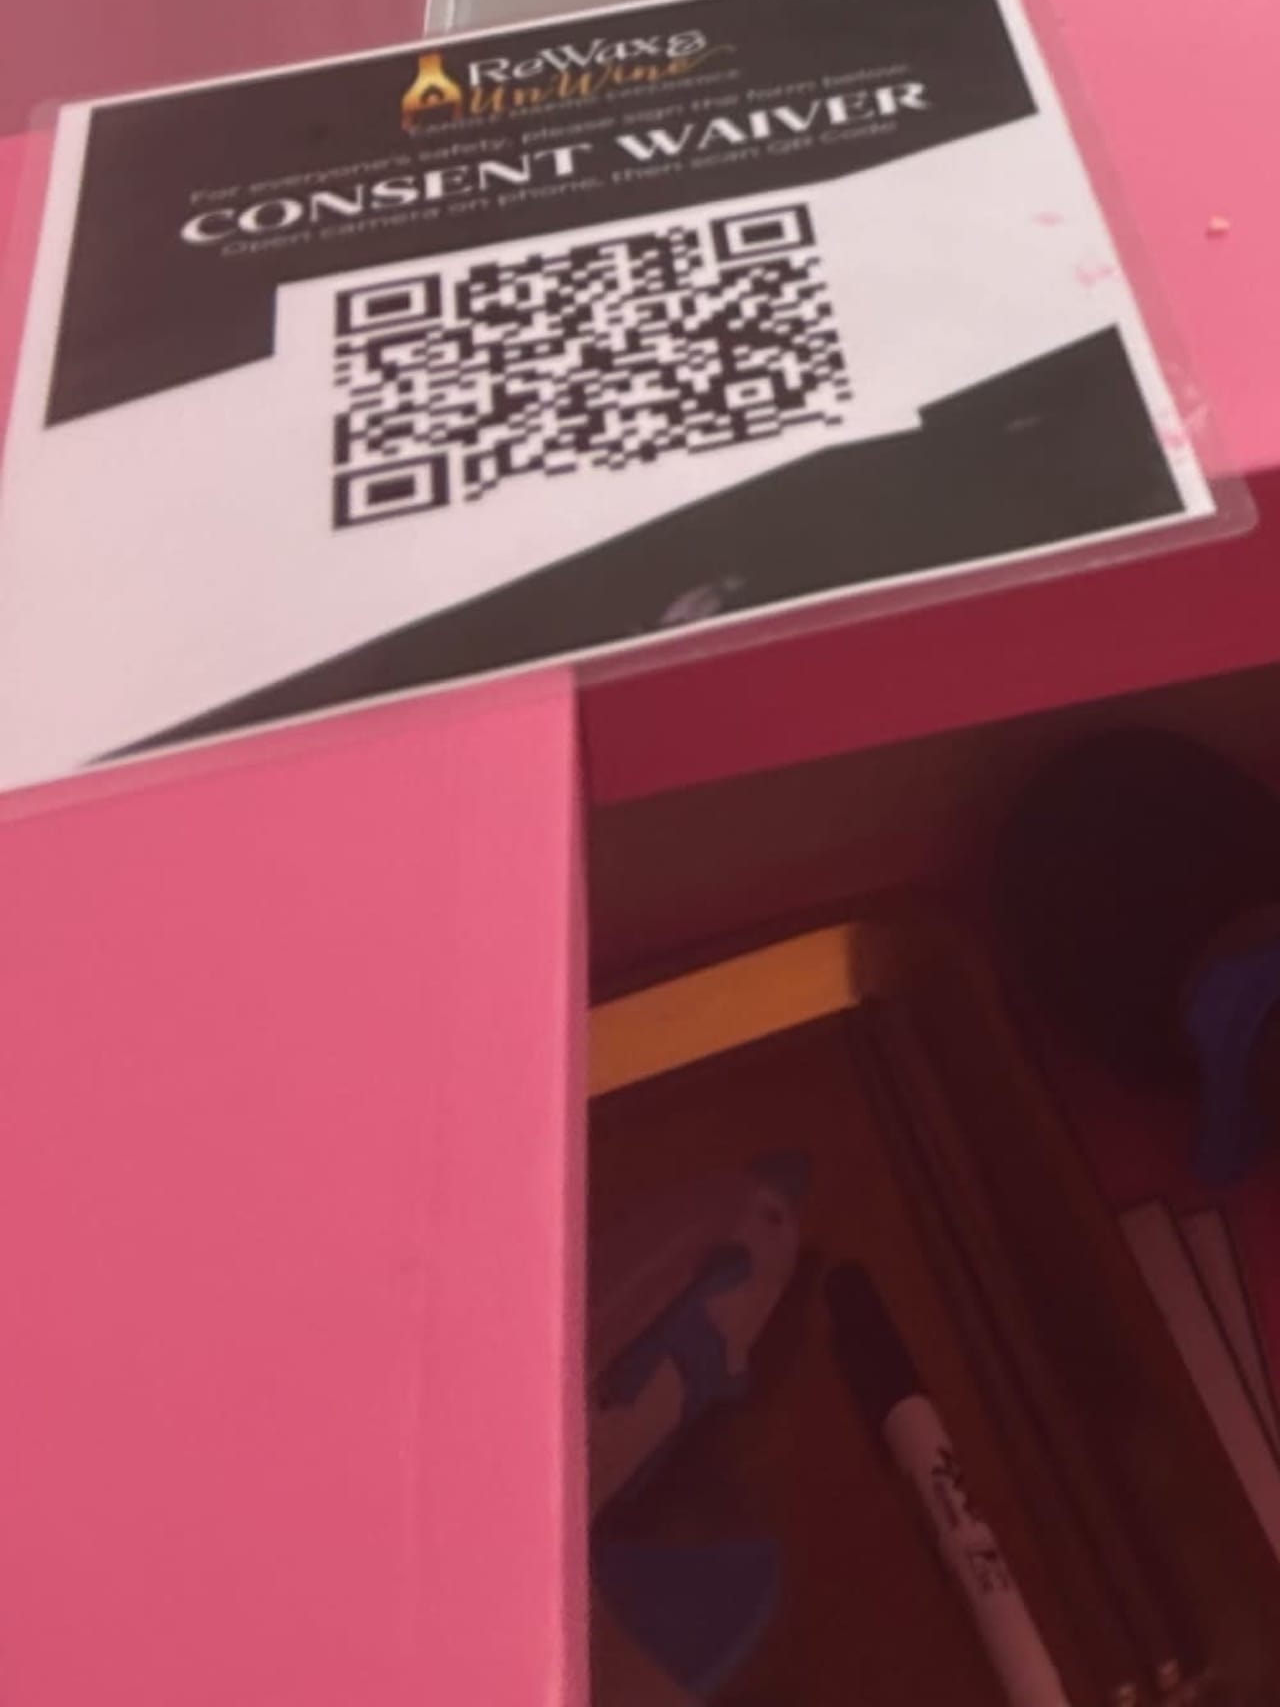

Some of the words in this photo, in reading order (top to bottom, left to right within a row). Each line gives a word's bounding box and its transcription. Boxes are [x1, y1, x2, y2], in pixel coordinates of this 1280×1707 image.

[181, 141, 593, 244] CONSENT
[616, 82, 930, 161] WAIVER
[249, 154, 411, 192] everyone's
[521, 117, 616, 145] please
[623, 102, 685, 126] sign
[691, 93, 739, 111] the
[746, 80, 816, 101] form
[220, 230, 311, 257] Open
[319, 207, 441, 239] camera
[446, 196, 490, 213] on
[612, 161, 683, 184] then
[690, 148, 759, 169] scan
